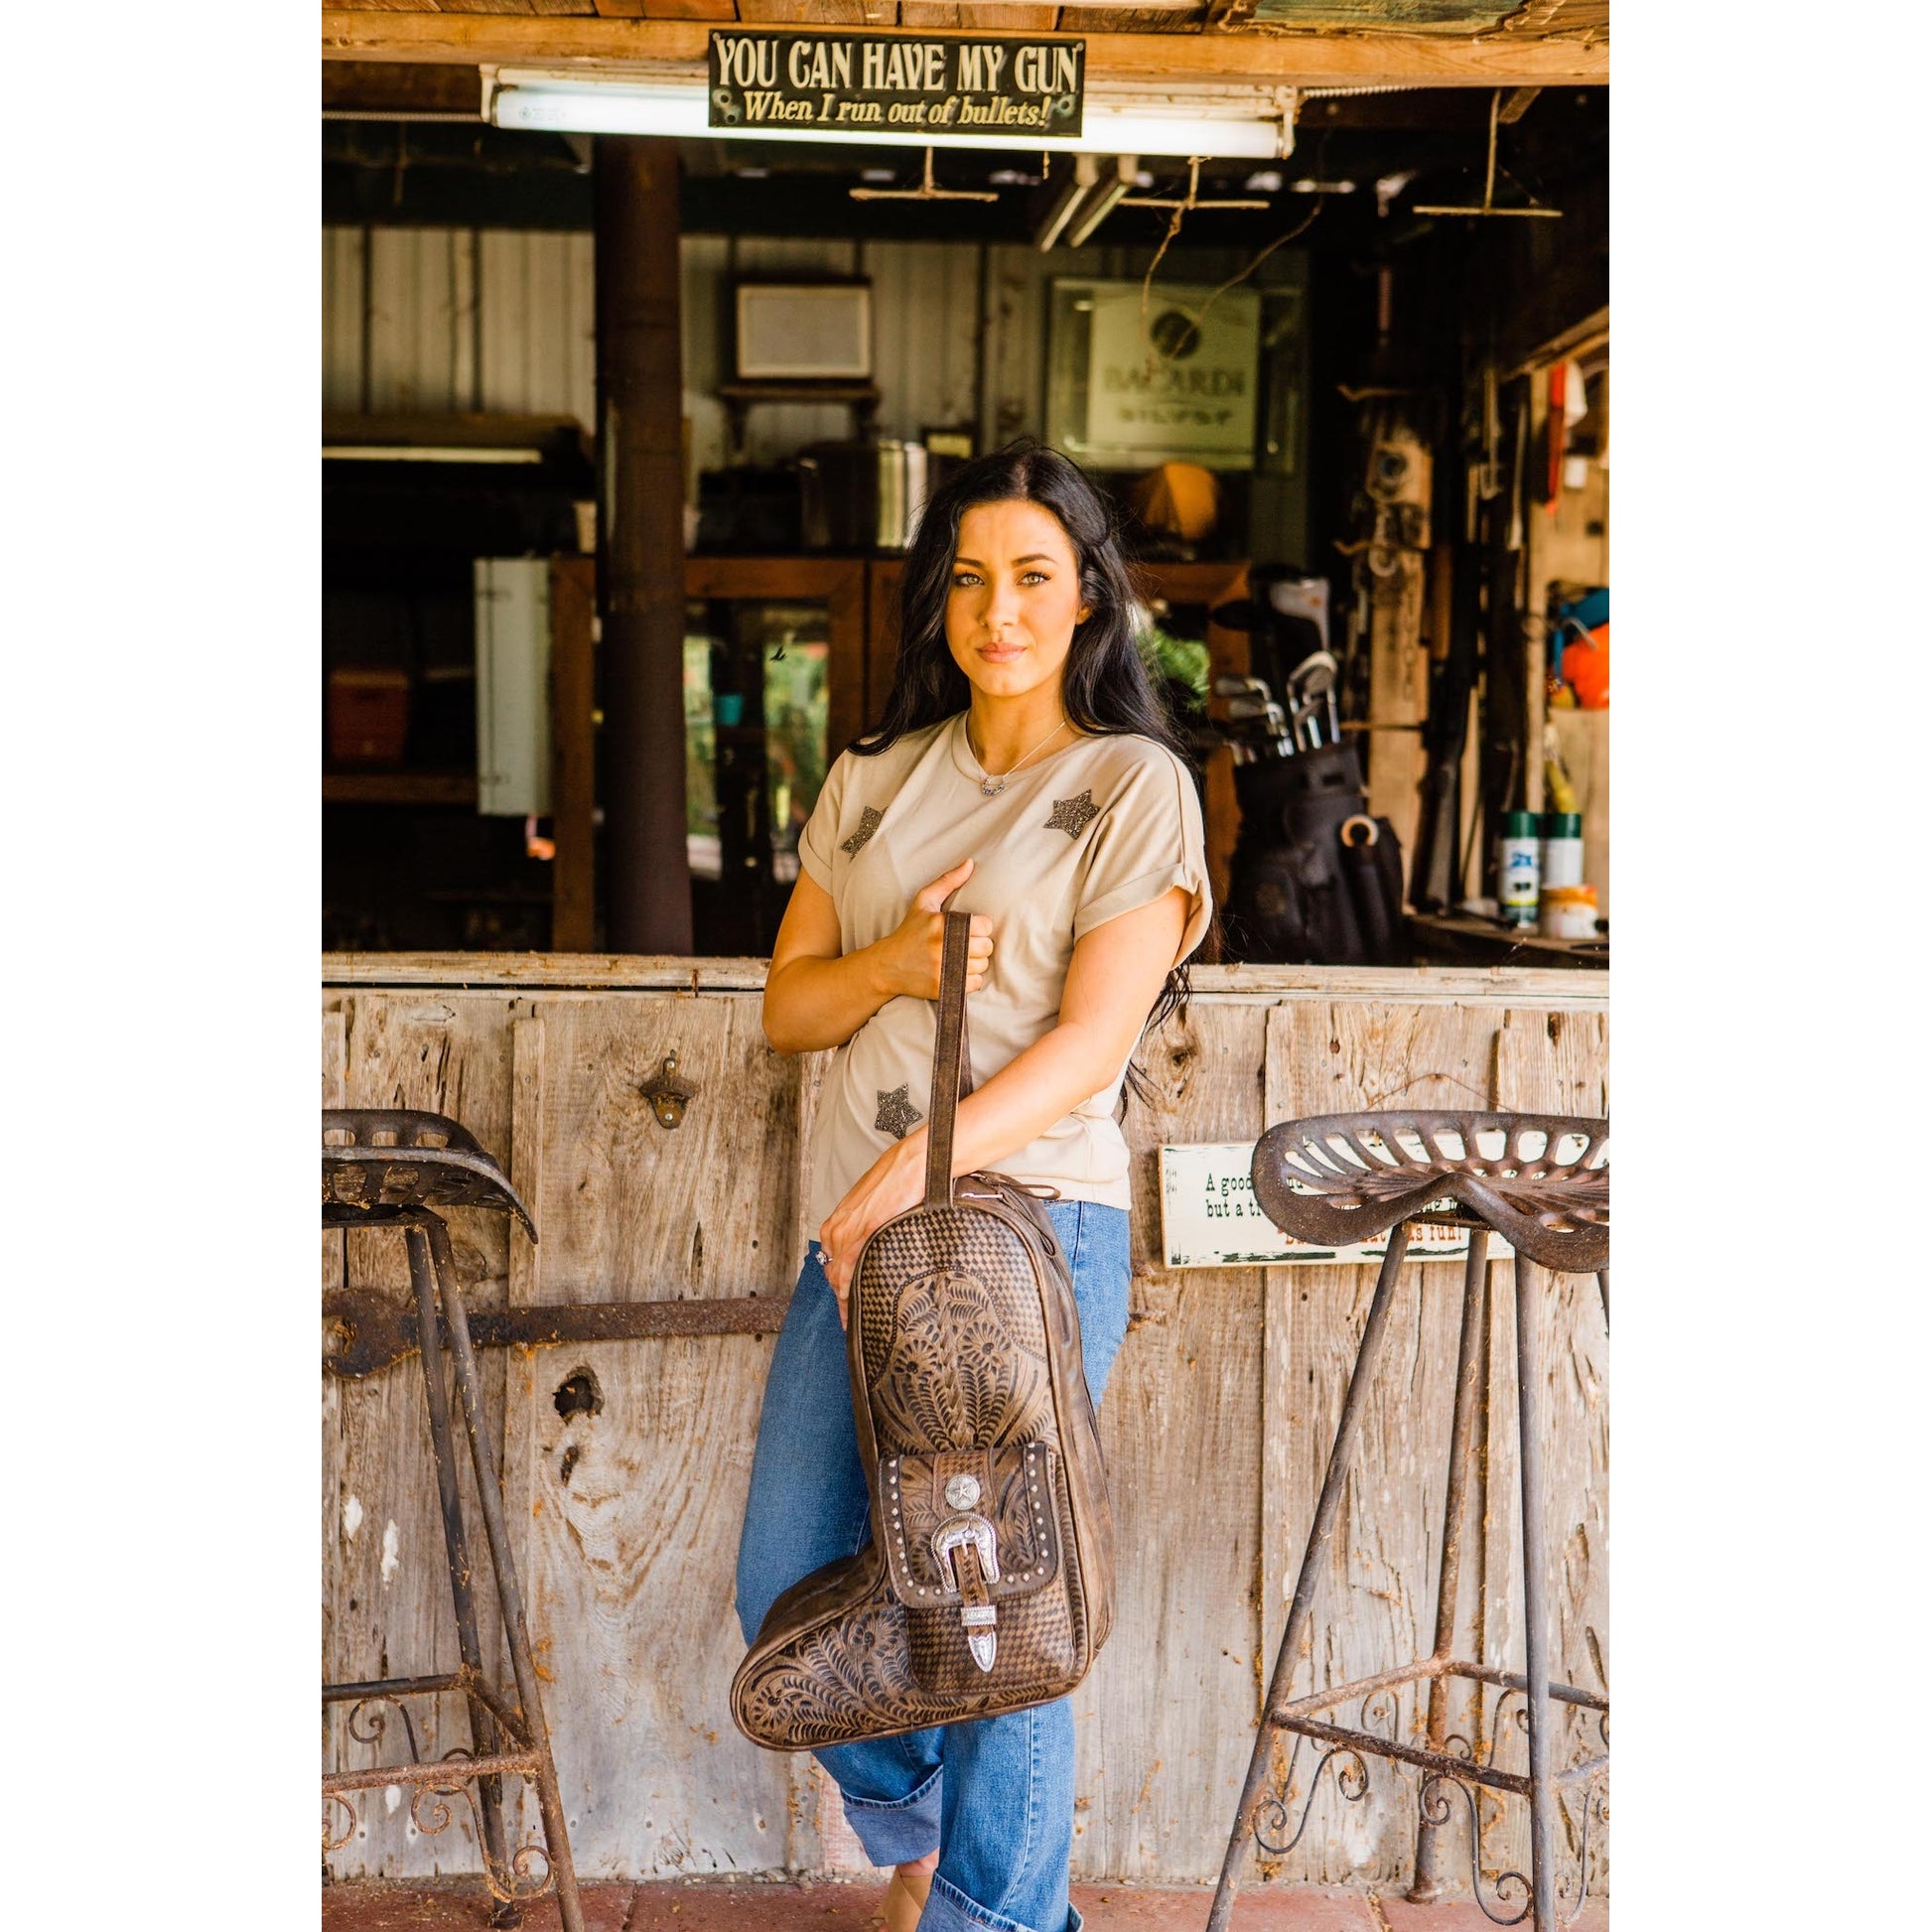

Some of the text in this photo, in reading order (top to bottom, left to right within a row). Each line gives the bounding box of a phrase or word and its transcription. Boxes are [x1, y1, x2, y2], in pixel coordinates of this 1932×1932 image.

[716, 38, 1079, 93] YOU CAN HAVE MY GUN
[744, 90, 1052, 126] When I run out of bullets!
[1205, 1173, 1215, 1191] A
[1205, 1198, 1230, 1217] but
[1235, 1203, 1243, 1216] a
